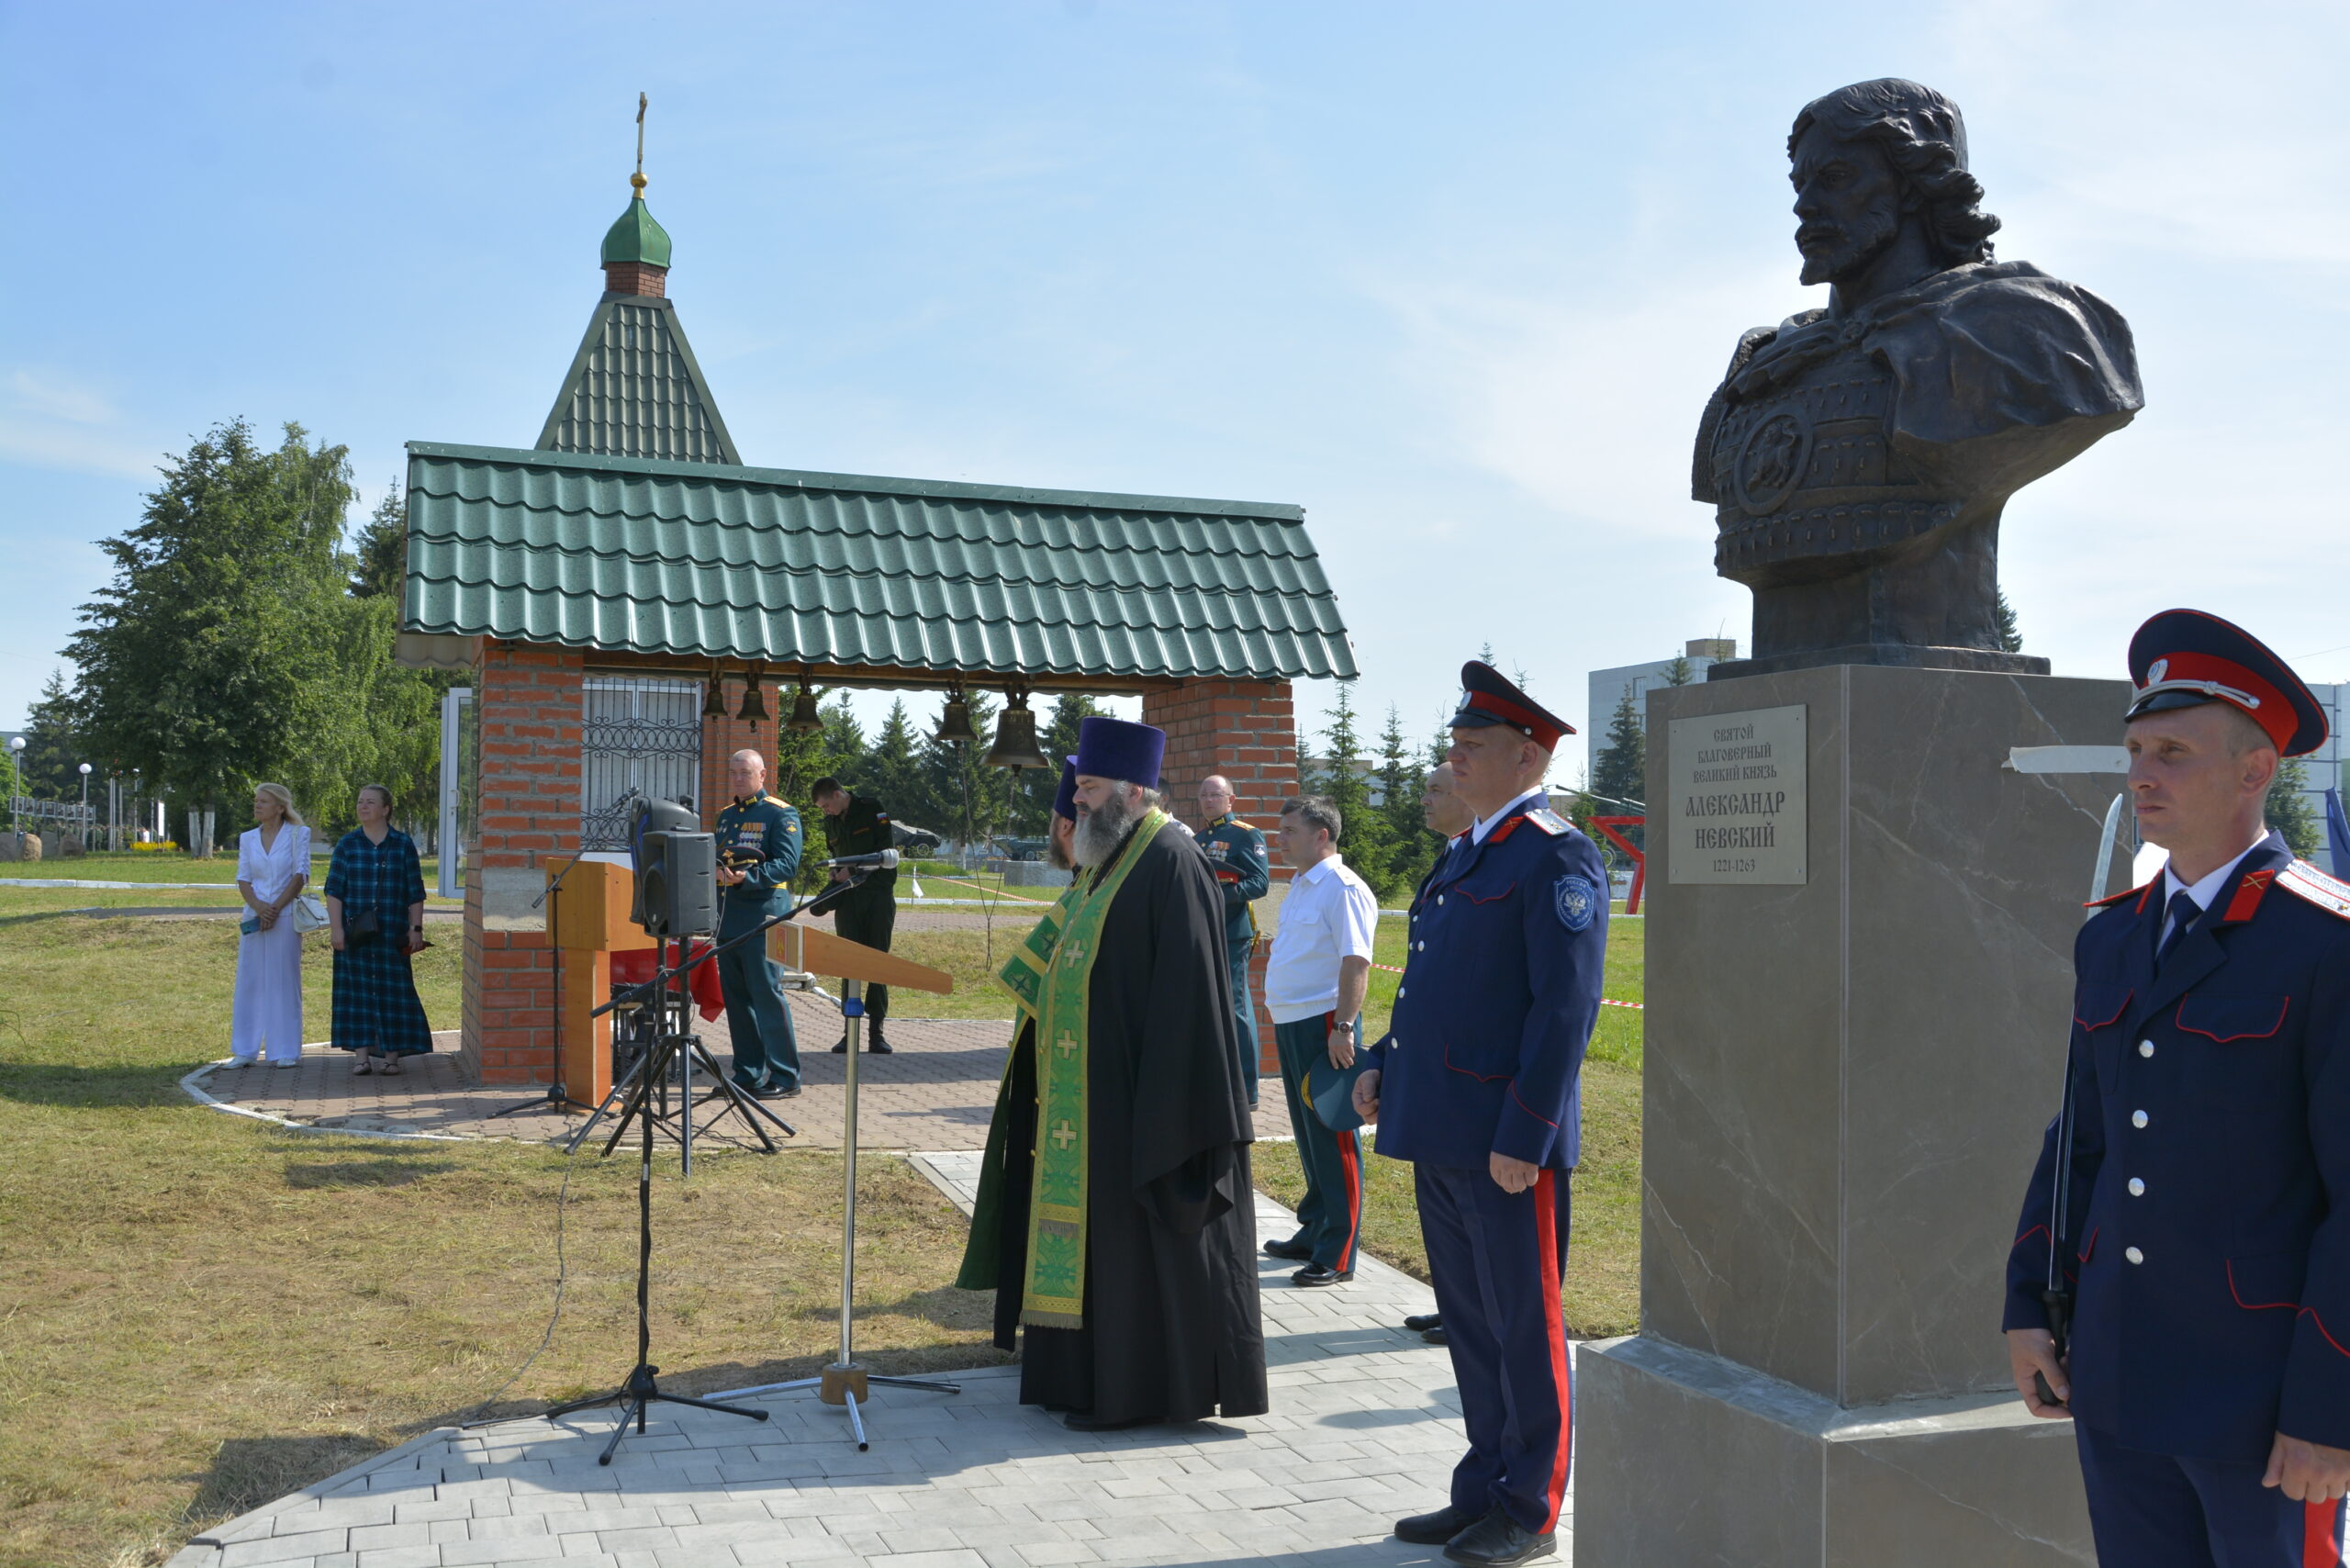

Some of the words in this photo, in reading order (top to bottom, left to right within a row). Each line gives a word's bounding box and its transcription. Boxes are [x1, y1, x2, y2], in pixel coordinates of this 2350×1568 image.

[1714, 723, 1754, 743] СВЯТОЙ
[1697, 742, 1772, 764] БЛАГОВЕРНЫЙ
[1693, 765, 1740, 784] ВЕЛИКИЙ
[1742, 764, 1777, 780] КНЯЗЬ
[1685, 791, 1785, 818] АЛЕКСАНДР
[1695, 822, 1774, 849] НЕВСКИЙ
[1713, 858, 1755, 873] 1221-1263
